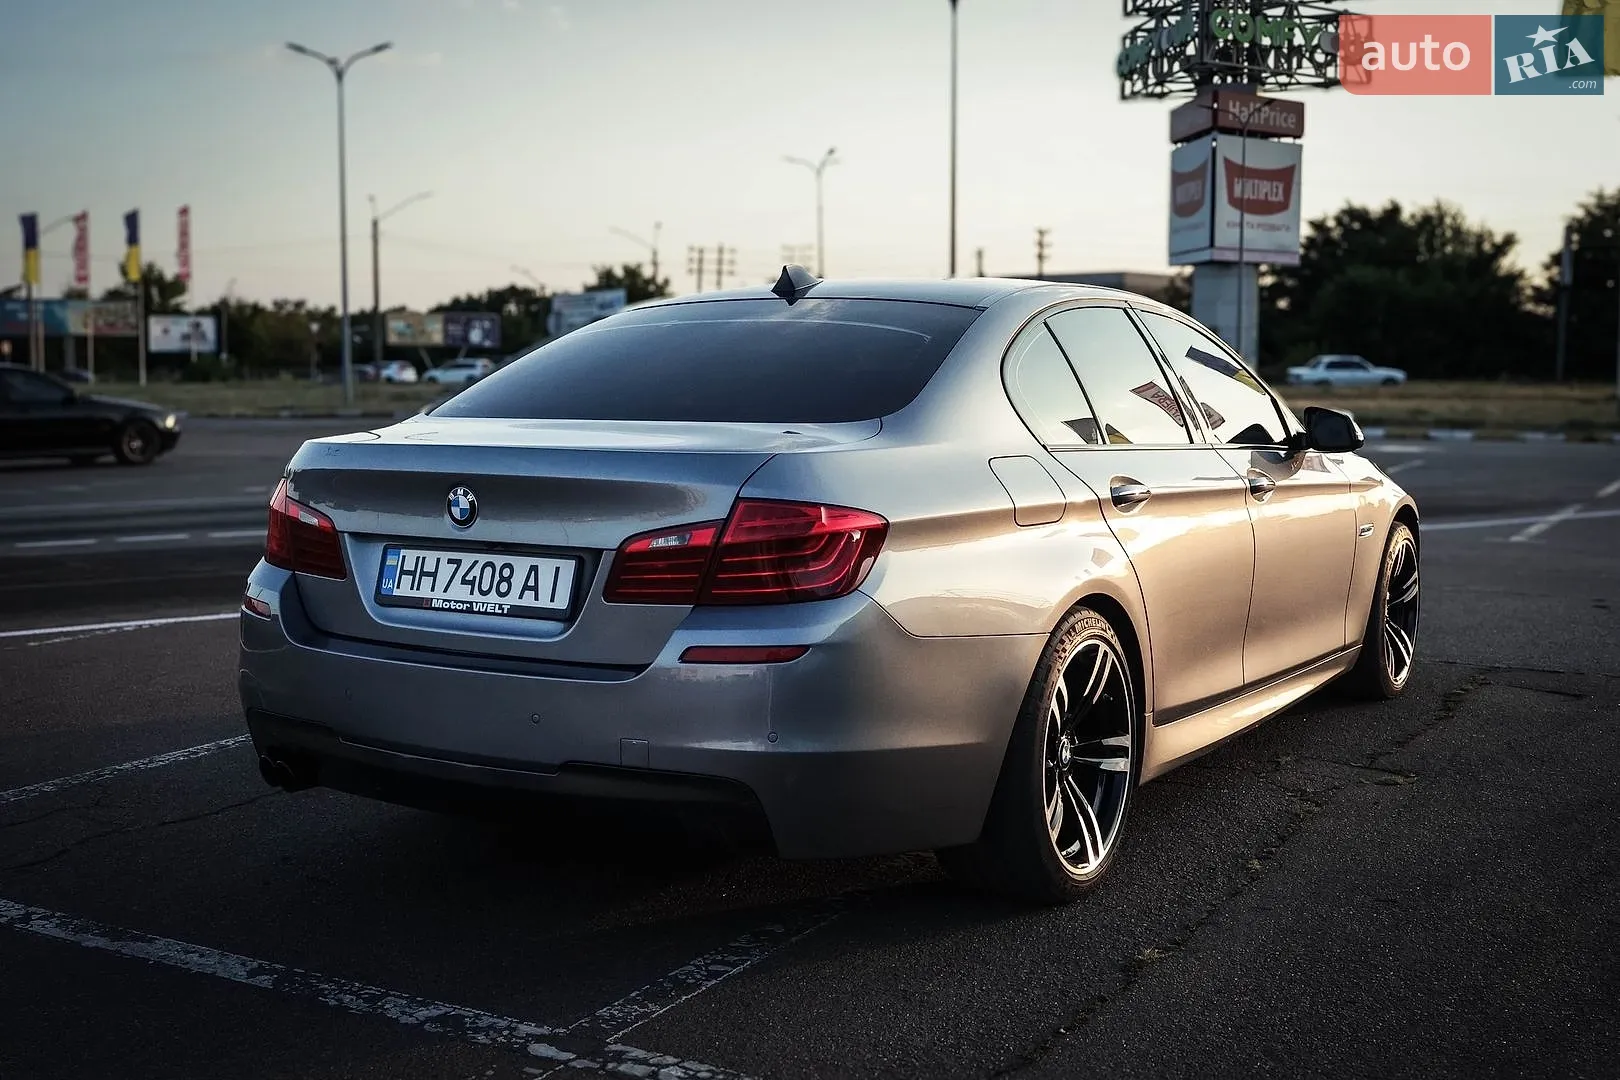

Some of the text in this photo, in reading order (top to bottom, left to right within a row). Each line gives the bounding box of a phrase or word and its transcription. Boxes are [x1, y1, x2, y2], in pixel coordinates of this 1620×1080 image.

[1211, 8, 1322, 50] COMFY
[1233, 177, 1285, 203] MULTIPLEX
[448, 488, 474, 502] BMW
[382, 579, 394, 590] UA
[432, 599, 511, 614] Motor WELT
